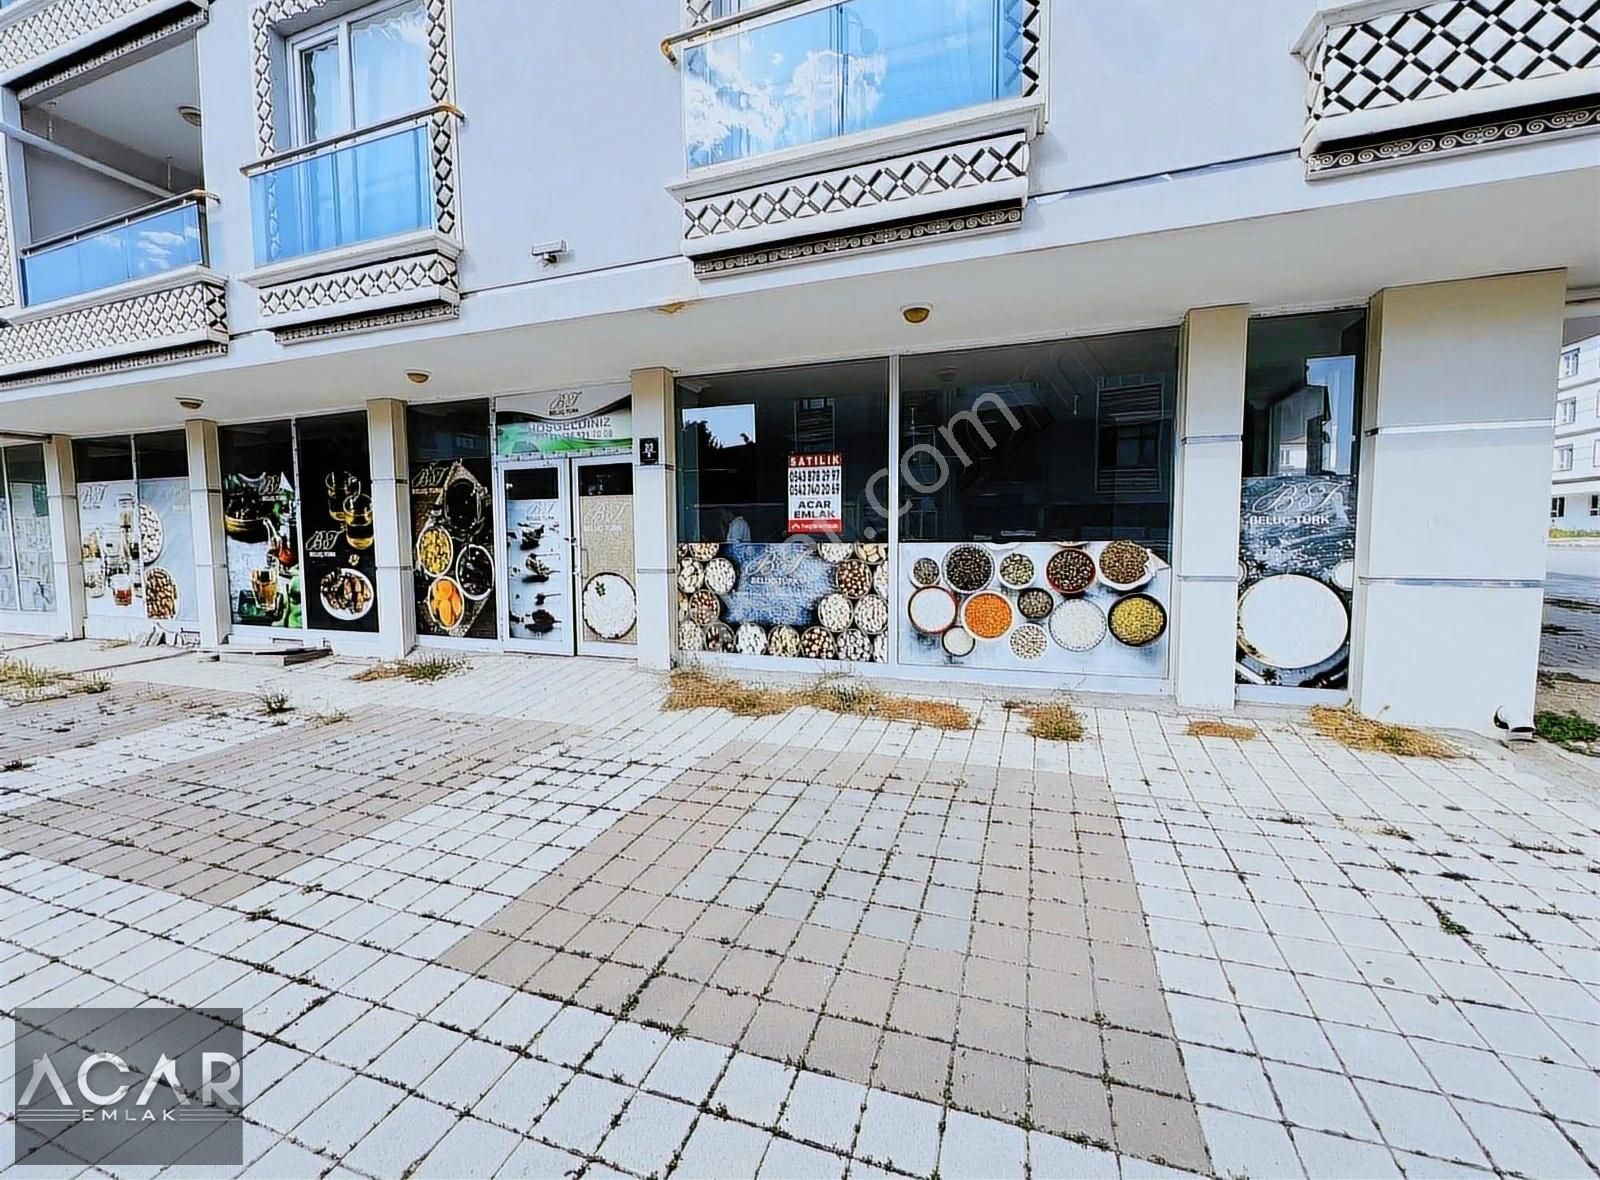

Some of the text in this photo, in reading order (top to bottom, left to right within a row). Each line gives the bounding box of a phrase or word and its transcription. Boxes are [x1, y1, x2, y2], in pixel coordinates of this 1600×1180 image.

[790, 454, 840, 467] SATILIK
[798, 500, 831, 509] ACAR
[794, 510, 836, 519] EMLAK
